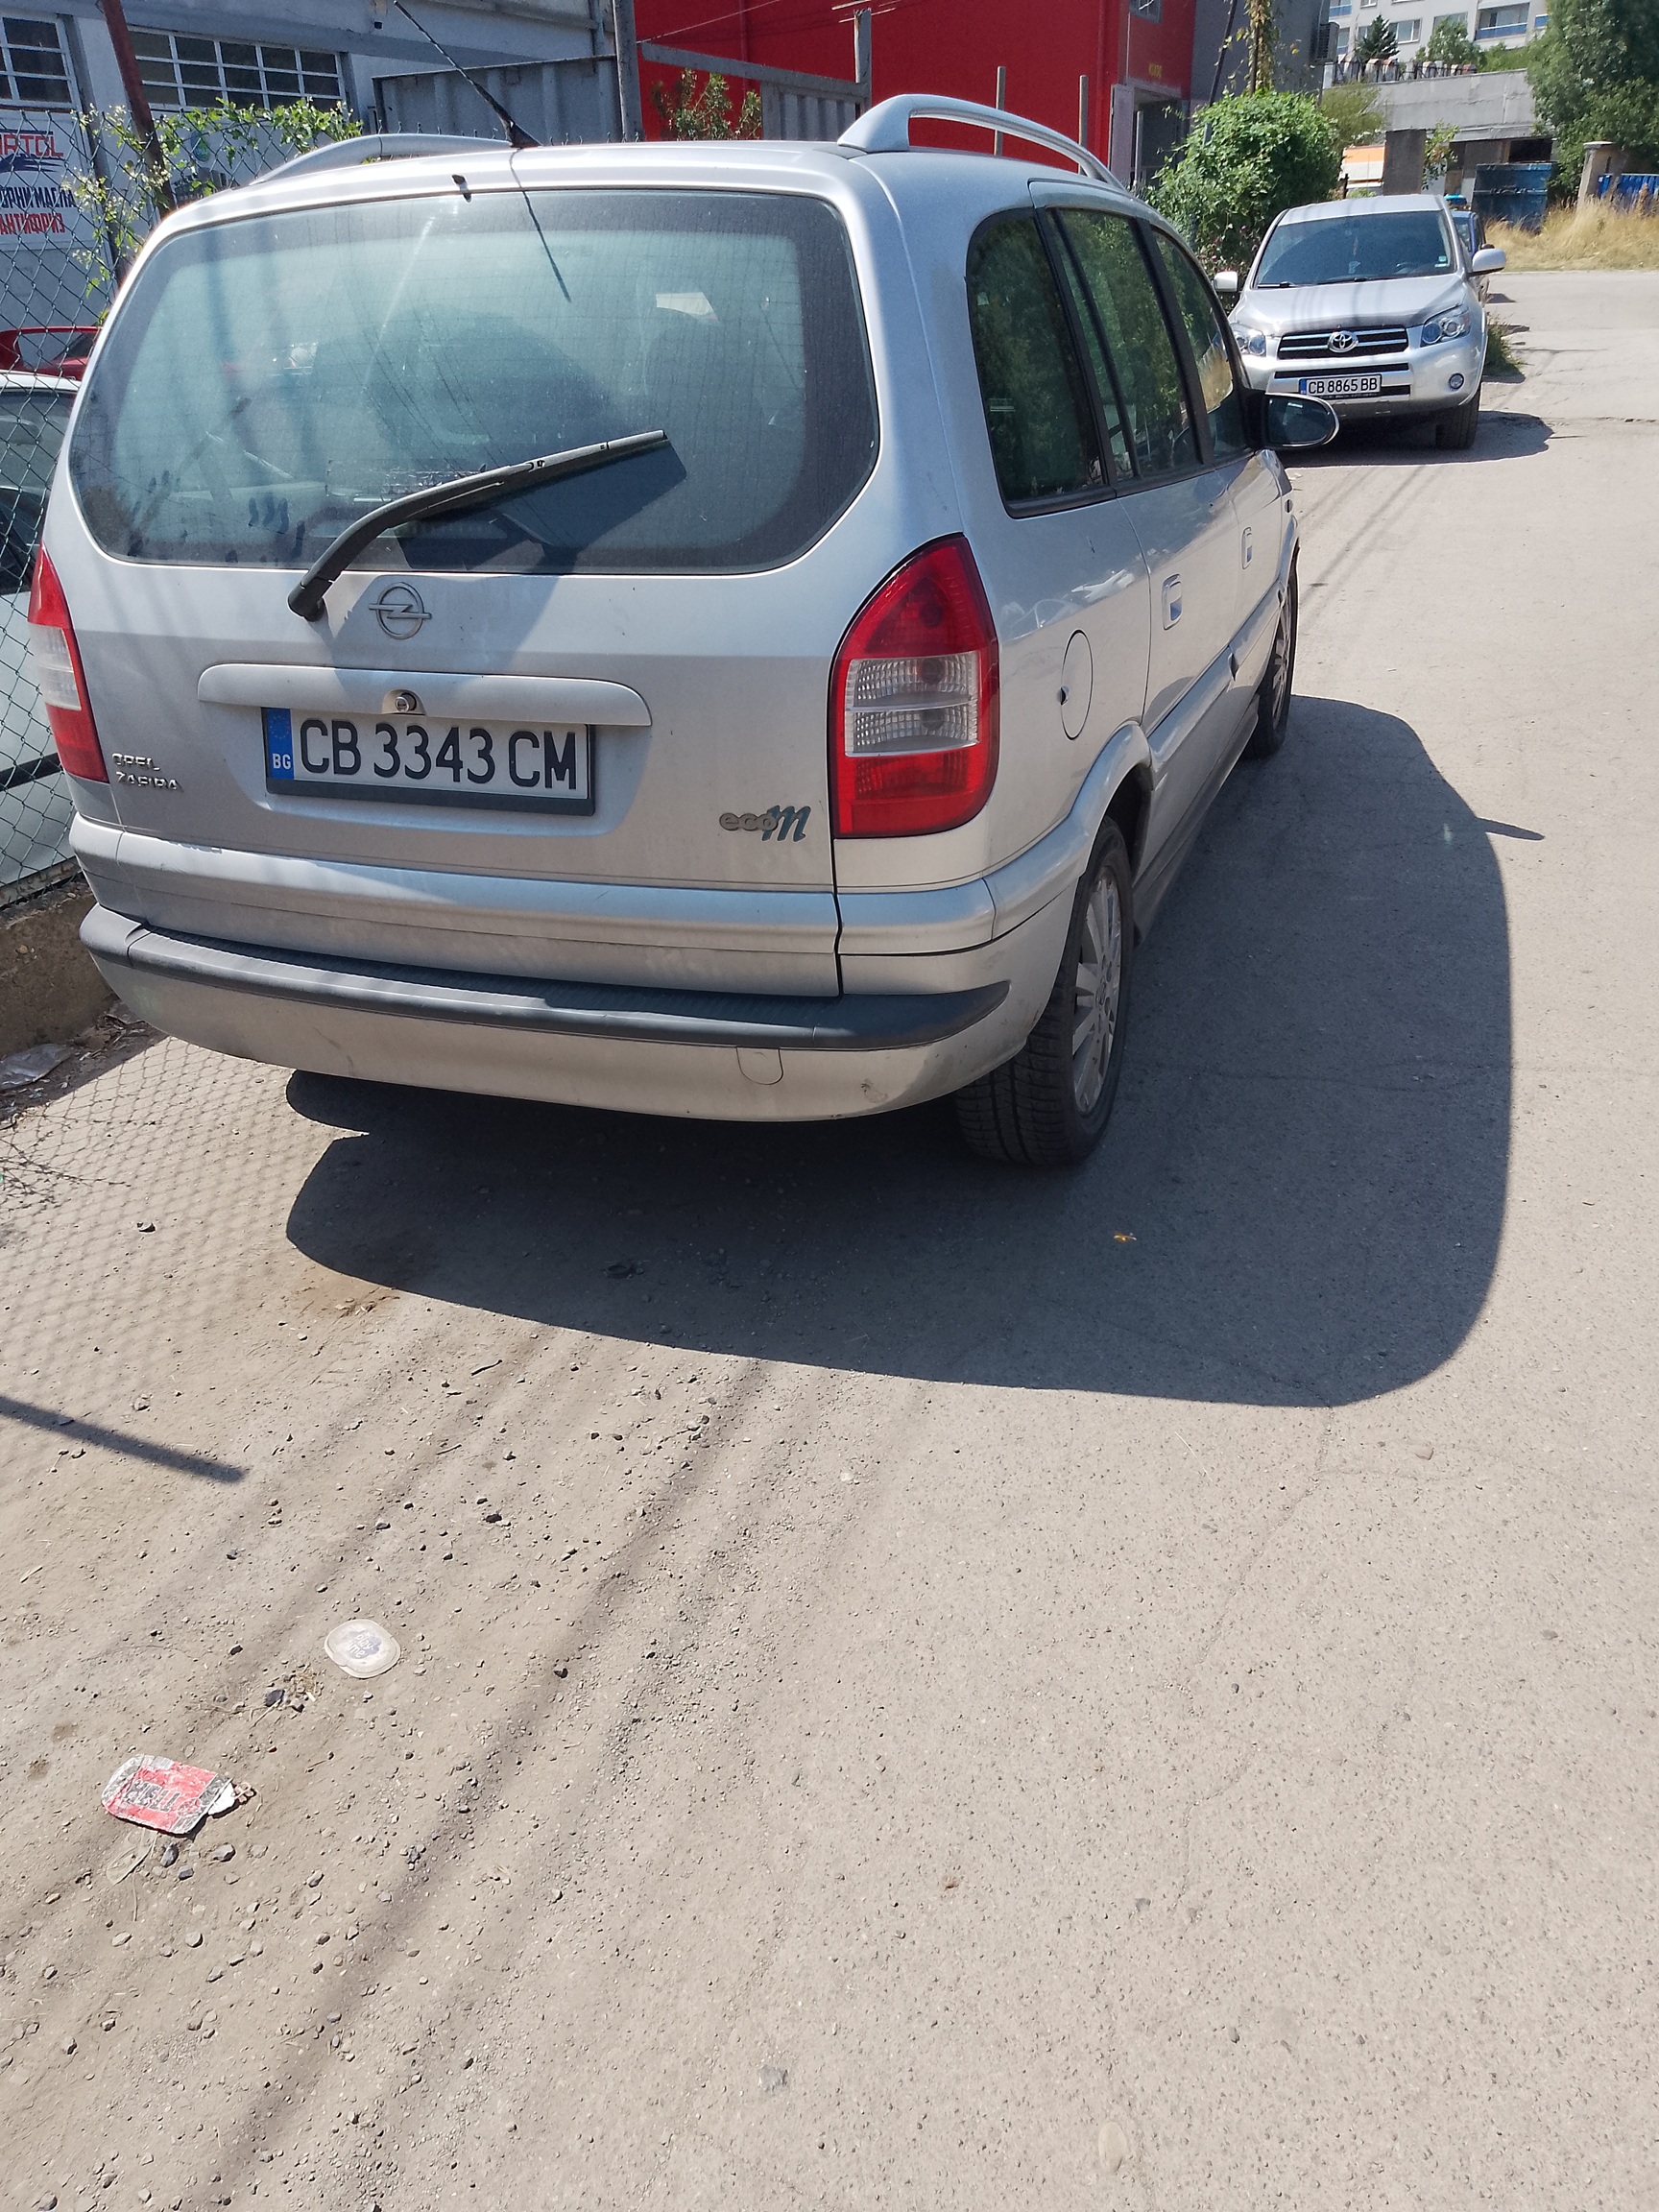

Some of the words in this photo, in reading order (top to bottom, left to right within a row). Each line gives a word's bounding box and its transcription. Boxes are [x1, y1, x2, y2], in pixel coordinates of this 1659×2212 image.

[1308, 380, 1325, 395] CB
[1327, 378, 1358, 393] 8865
[1360, 376, 1378, 392] BB
[111, 753, 161, 772] OPEL
[272, 753, 291, 770] BG
[300, 719, 362, 776] CB
[373, 722, 496, 785] 3343
[508, 730, 577, 790] CM
